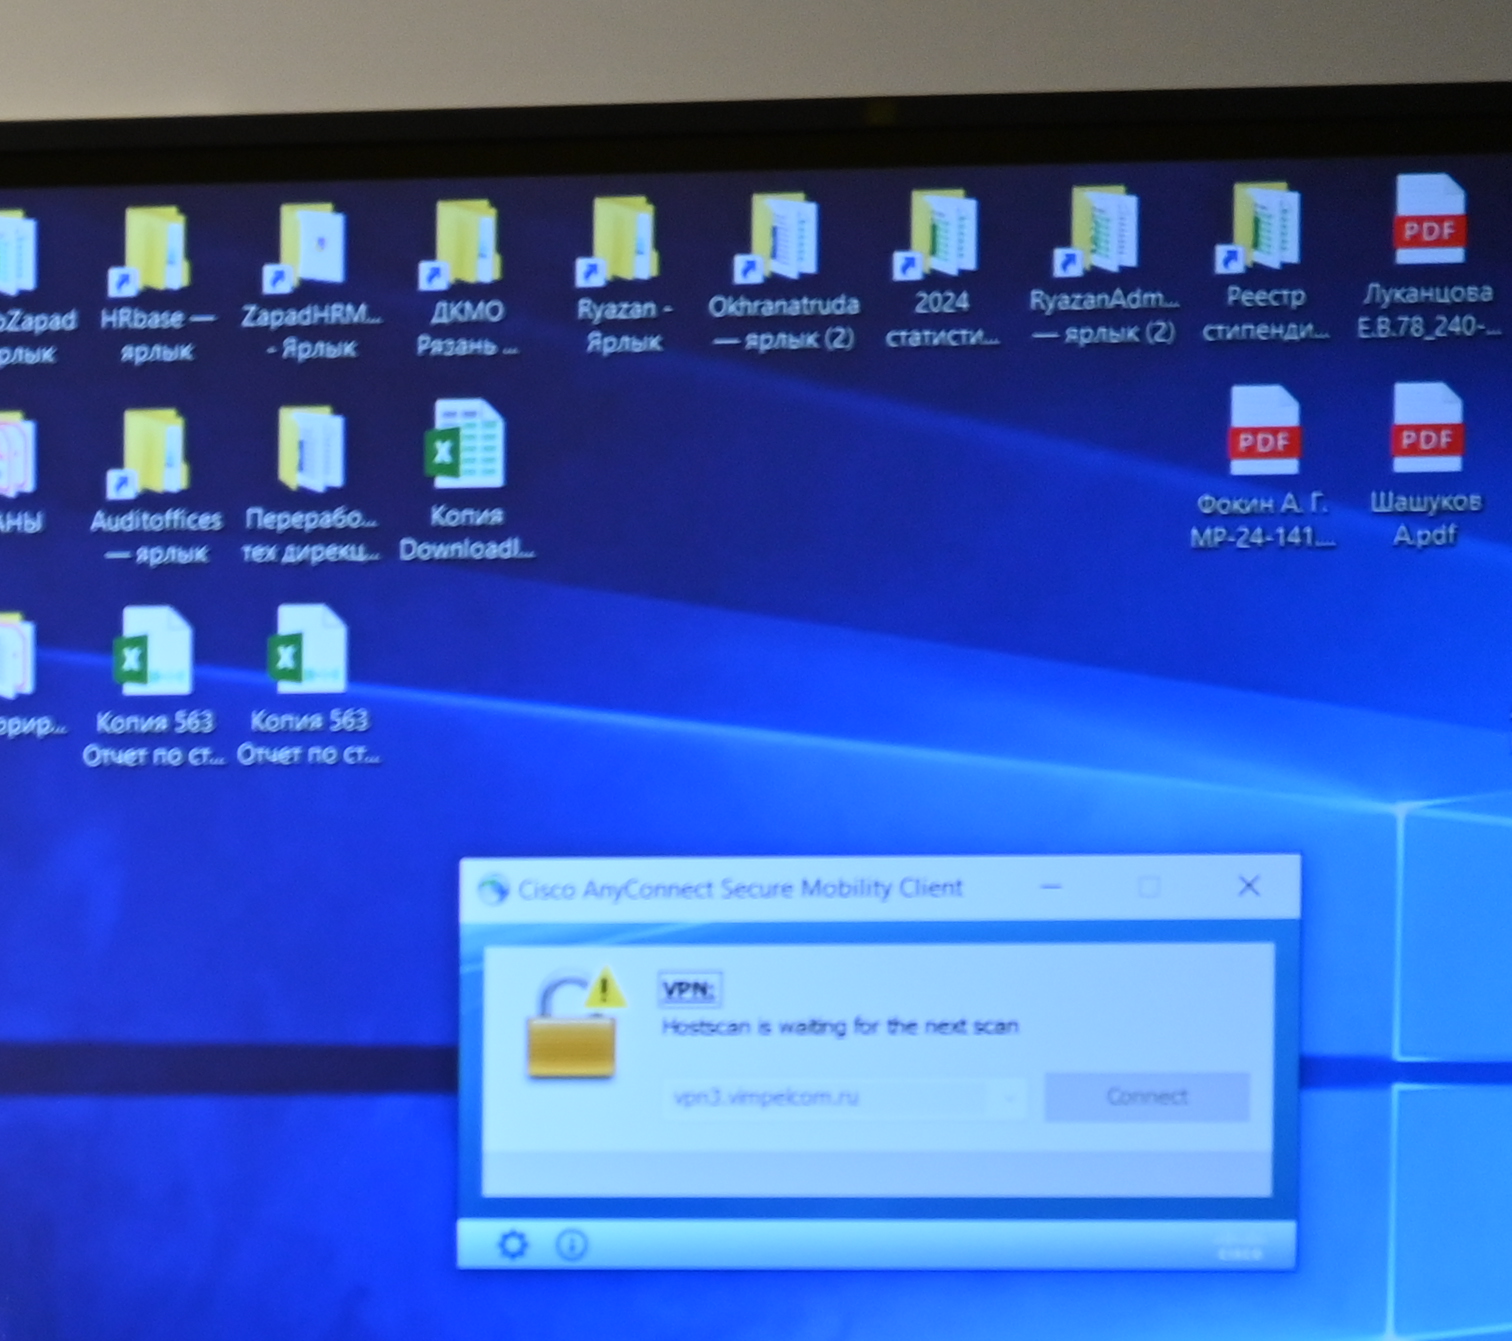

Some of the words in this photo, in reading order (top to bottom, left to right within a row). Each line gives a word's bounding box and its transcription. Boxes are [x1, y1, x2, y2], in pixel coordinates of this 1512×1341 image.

[1402, 219, 1455, 242] PDF
[707, 293, 861, 318] Okhranatruda
[914, 290, 971, 314] 2024
[1226, 284, 1307, 310] Реестр
[1362, 281, 1494, 310] Луканцова
[100, 306, 186, 330] HRbase
[430, 299, 505, 326] ДКМО
[577, 297, 657, 323] Ryazan
[416, 333, 499, 357] Рязань
[586, 330, 663, 357] Ярлык
[744, 331, 820, 354] ярлык
[823, 325, 855, 352] (2)
[1064, 325, 1140, 348] ярлык
[1144, 319, 1176, 345] (2)
[120, 343, 194, 366] ярлык
[281, 335, 358, 363] Ярлык
[1237, 431, 1289, 453] PDF
[1399, 429, 1452, 451] PDF
[430, 504, 505, 528] Копия
[1196, 493, 1275, 515] Фокин
[1370, 490, 1482, 517] Шашуков
[89, 507, 223, 533] Auditoffices
[135, 545, 209, 568] ярлык
[241, 543, 278, 564] тех
[96, 710, 170, 735] Копия
[174, 709, 215, 734] 563
[250, 708, 324, 733] Копия
[329, 707, 370, 732] 563
[82, 742, 149, 768] Отчет
[152, 746, 184, 767] по
[236, 741, 303, 766] Отчет
[307, 745, 339, 765] по
[517, 878, 578, 902] Cisco
[582, 877, 715, 905] AnyConnect
[720, 877, 795, 900] Secure
[800, 877, 894, 904] Mobility
[898, 876, 964, 899] Client
[663, 981, 714, 1000] VPN:
[661, 1019, 752, 1037] Hostscan
[757, 1020, 773, 1037] is
[778, 1017, 848, 1041] waiting
[852, 1015, 881, 1036] for
[886, 1017, 919, 1036] the
[924, 1018, 968, 1036] next
[972, 1019, 1020, 1036] scan
[1105, 1085, 1190, 1107] Connect
